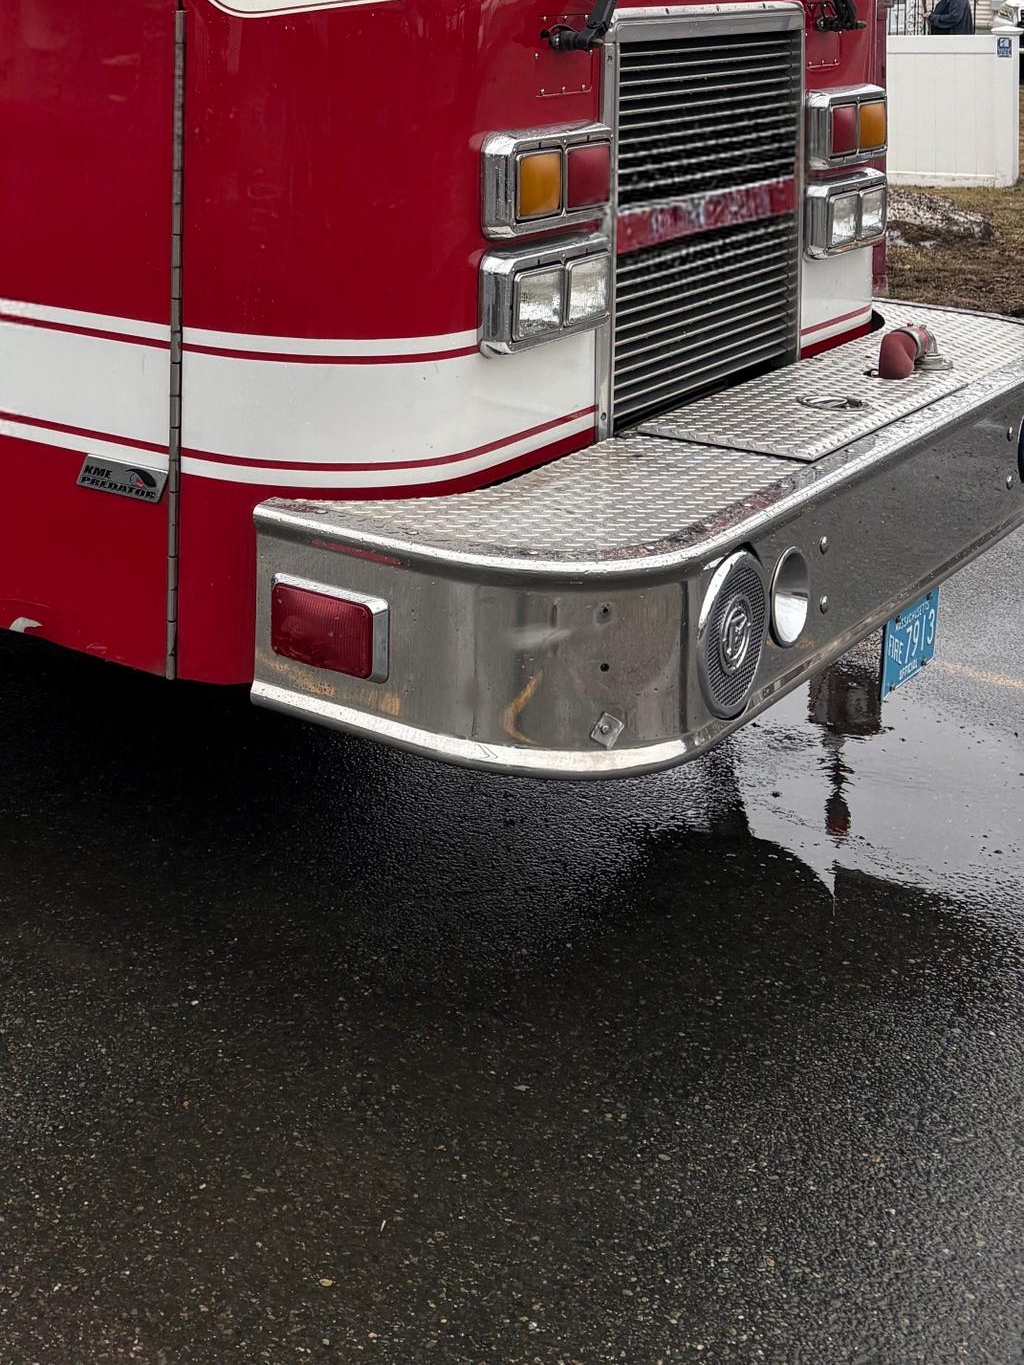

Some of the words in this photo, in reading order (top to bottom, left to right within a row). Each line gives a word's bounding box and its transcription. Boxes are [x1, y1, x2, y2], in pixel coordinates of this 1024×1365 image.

[83, 465, 113, 480] KME
[80, 476, 157, 500] PREDATOR
[887, 634, 904, 665] FIRE
[904, 608, 936, 664] 7913
